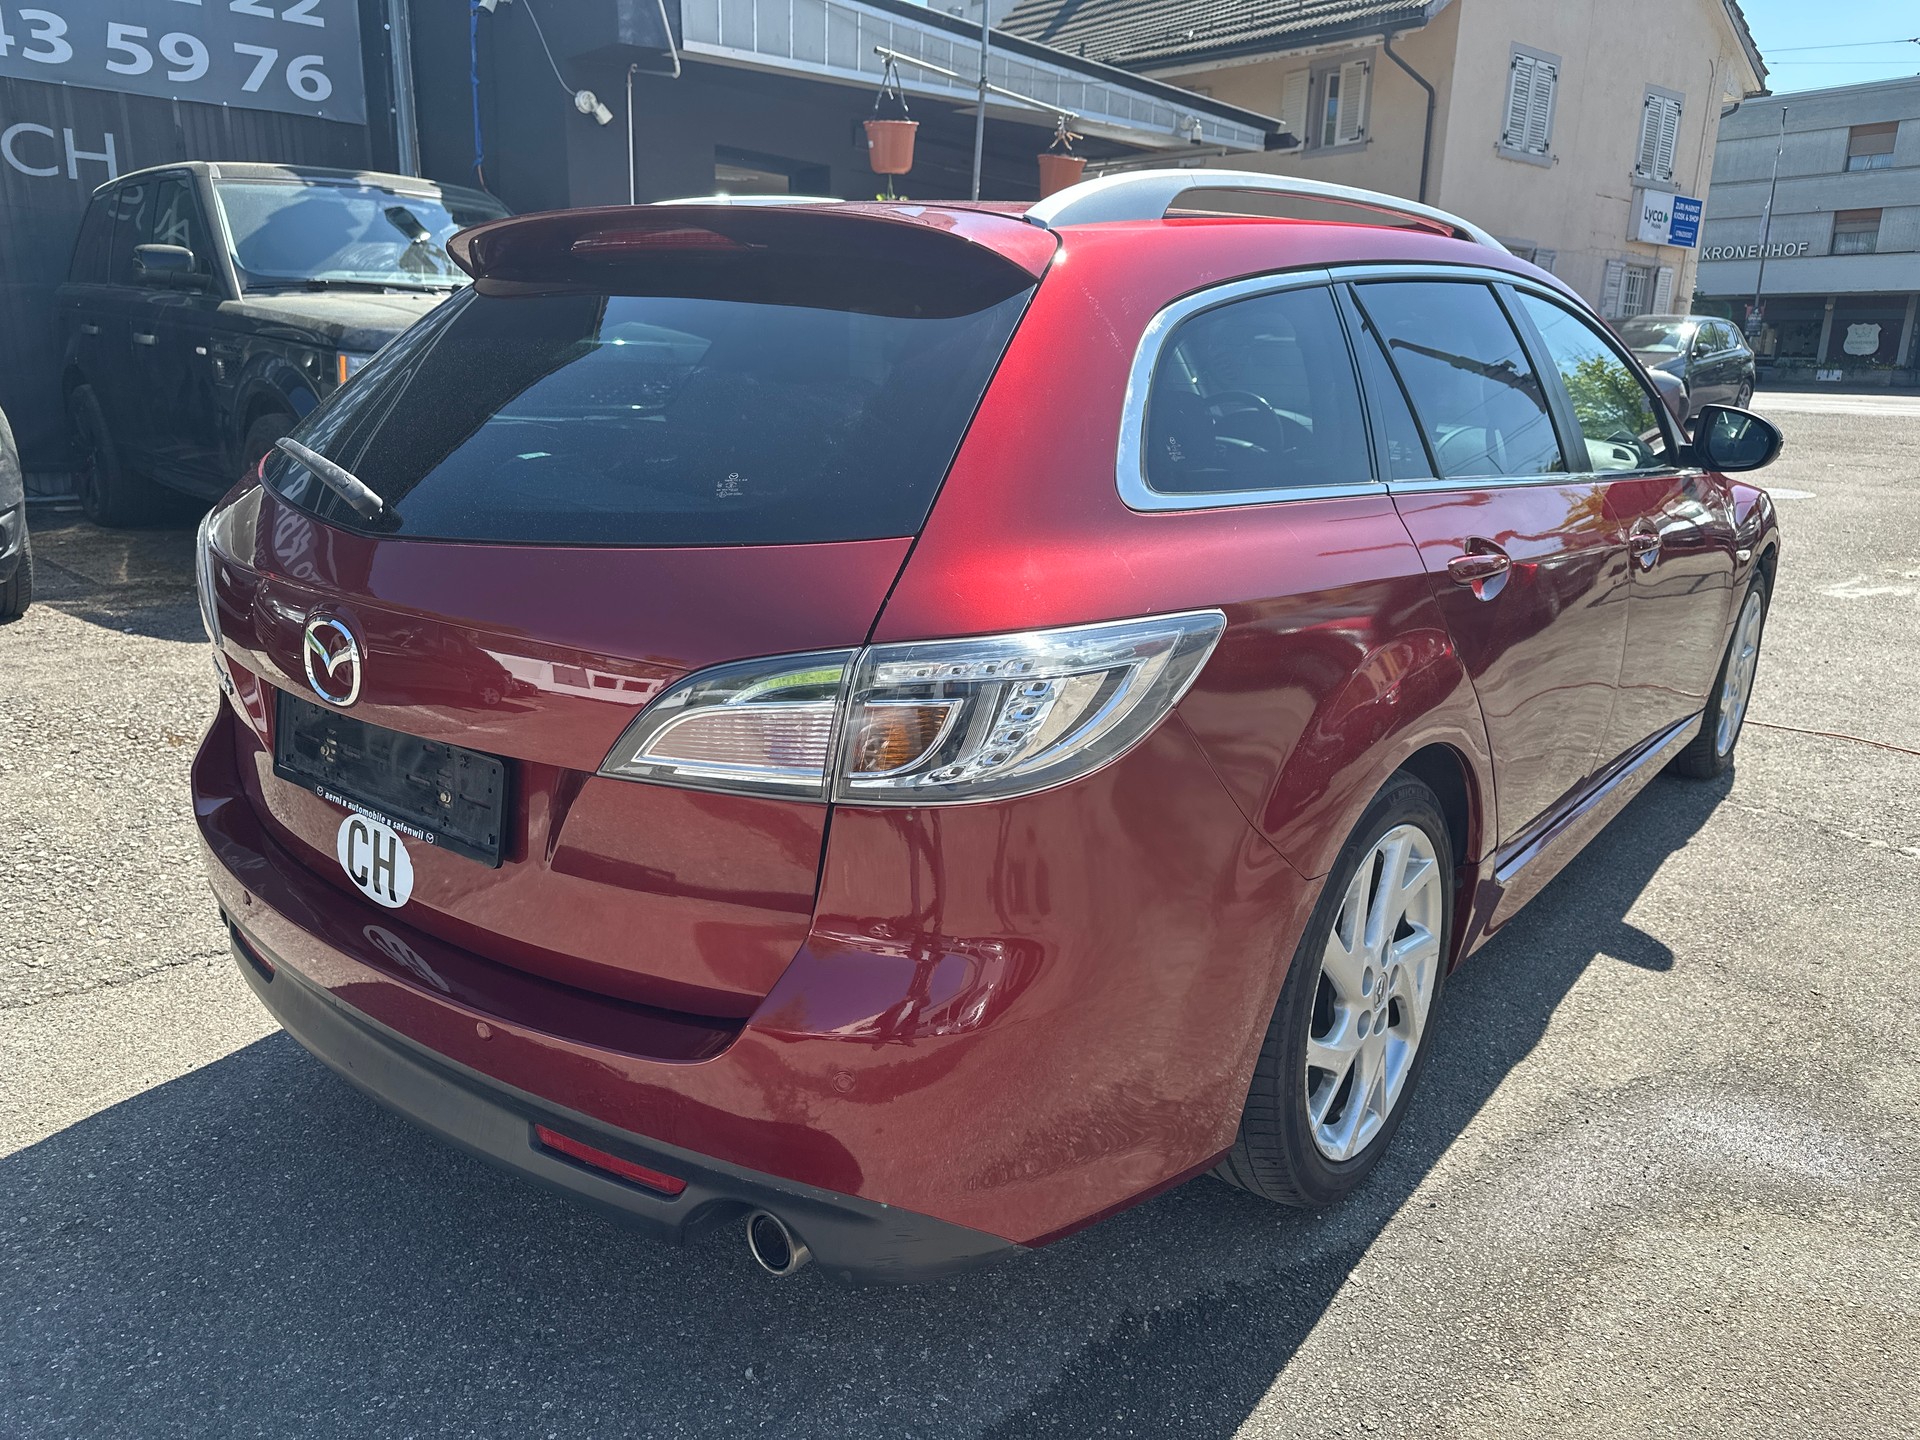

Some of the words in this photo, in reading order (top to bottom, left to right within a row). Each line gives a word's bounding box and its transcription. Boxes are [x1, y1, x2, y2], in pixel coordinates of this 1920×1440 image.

[105, 21, 210, 82] 59
[233, 42, 333, 102] 76
[1644, 205, 1663, 224] Lyca
[1701, 242, 1809, 260] KRONENHOF
[324, 791, 343, 807] aerni
[347, 801, 386, 824] automobile
[392, 820, 425, 841] safenwil
[347, 818, 398, 903] CH
